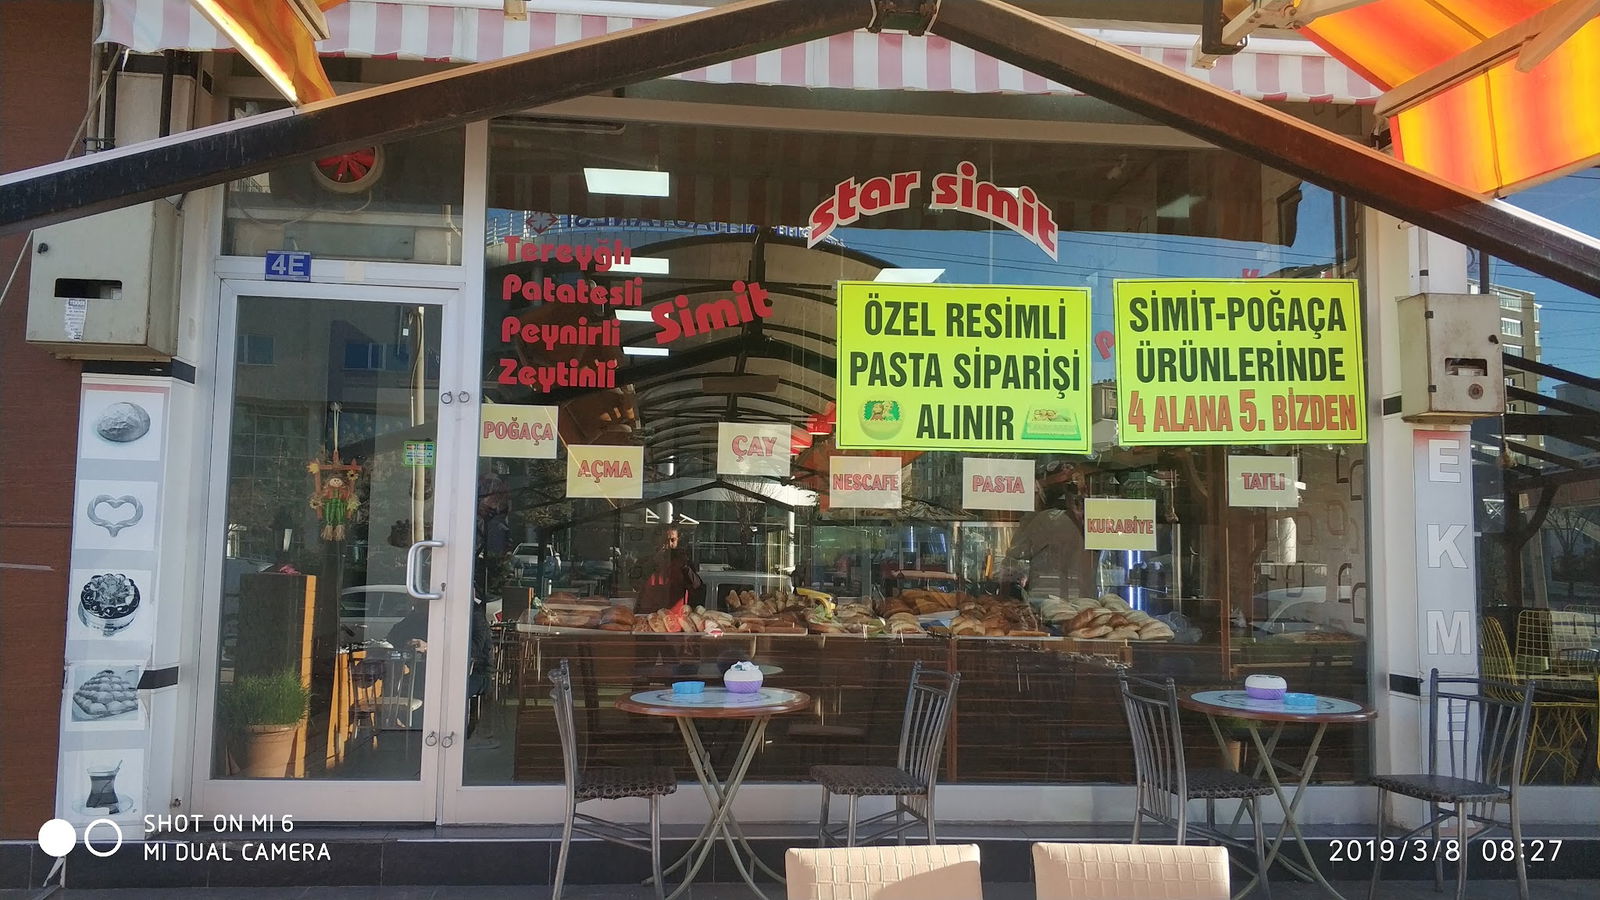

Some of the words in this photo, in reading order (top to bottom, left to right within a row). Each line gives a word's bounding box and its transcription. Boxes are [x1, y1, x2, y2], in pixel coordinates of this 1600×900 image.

[809, 172, 919, 246] star
[932, 161, 1058, 261] simit
[271, 254, 305, 276] 4E
[502, 274, 644, 307] Patatesli
[650, 280, 774, 345] Simit
[864, 293, 936, 337] ÖZEL
[946, 296, 1066, 340] RESİMLİ
[1129, 289, 1347, 340] SİMİT-POĞAÇA
[501, 316, 621, 350] Peynirli
[498, 358, 616, 392] Zeytinli
[849, 351, 943, 388] PASTA
[953, 346, 1080, 399] SİPARİŞİ
[1136, 340, 1346, 383] ÜRÜNLERİNDE
[916, 403, 1015, 441] ALINIR
[1128, 390, 1146, 433] 4
[1153, 395, 1233, 432] ALANA
[1239, 388, 1266, 432] 5.
[1271, 387, 1357, 431] BİZDEN
[483, 416, 554, 446] POĞAÇA
[731, 434, 778, 463] ÇAY
[577, 459, 633, 484] AÇMA
[832, 473, 899, 492] NESCAFE
[972, 475, 1025, 494] PASTA
[1241, 472, 1286, 491] TATLI
[1087, 515, 1154, 535] KURABİYE
